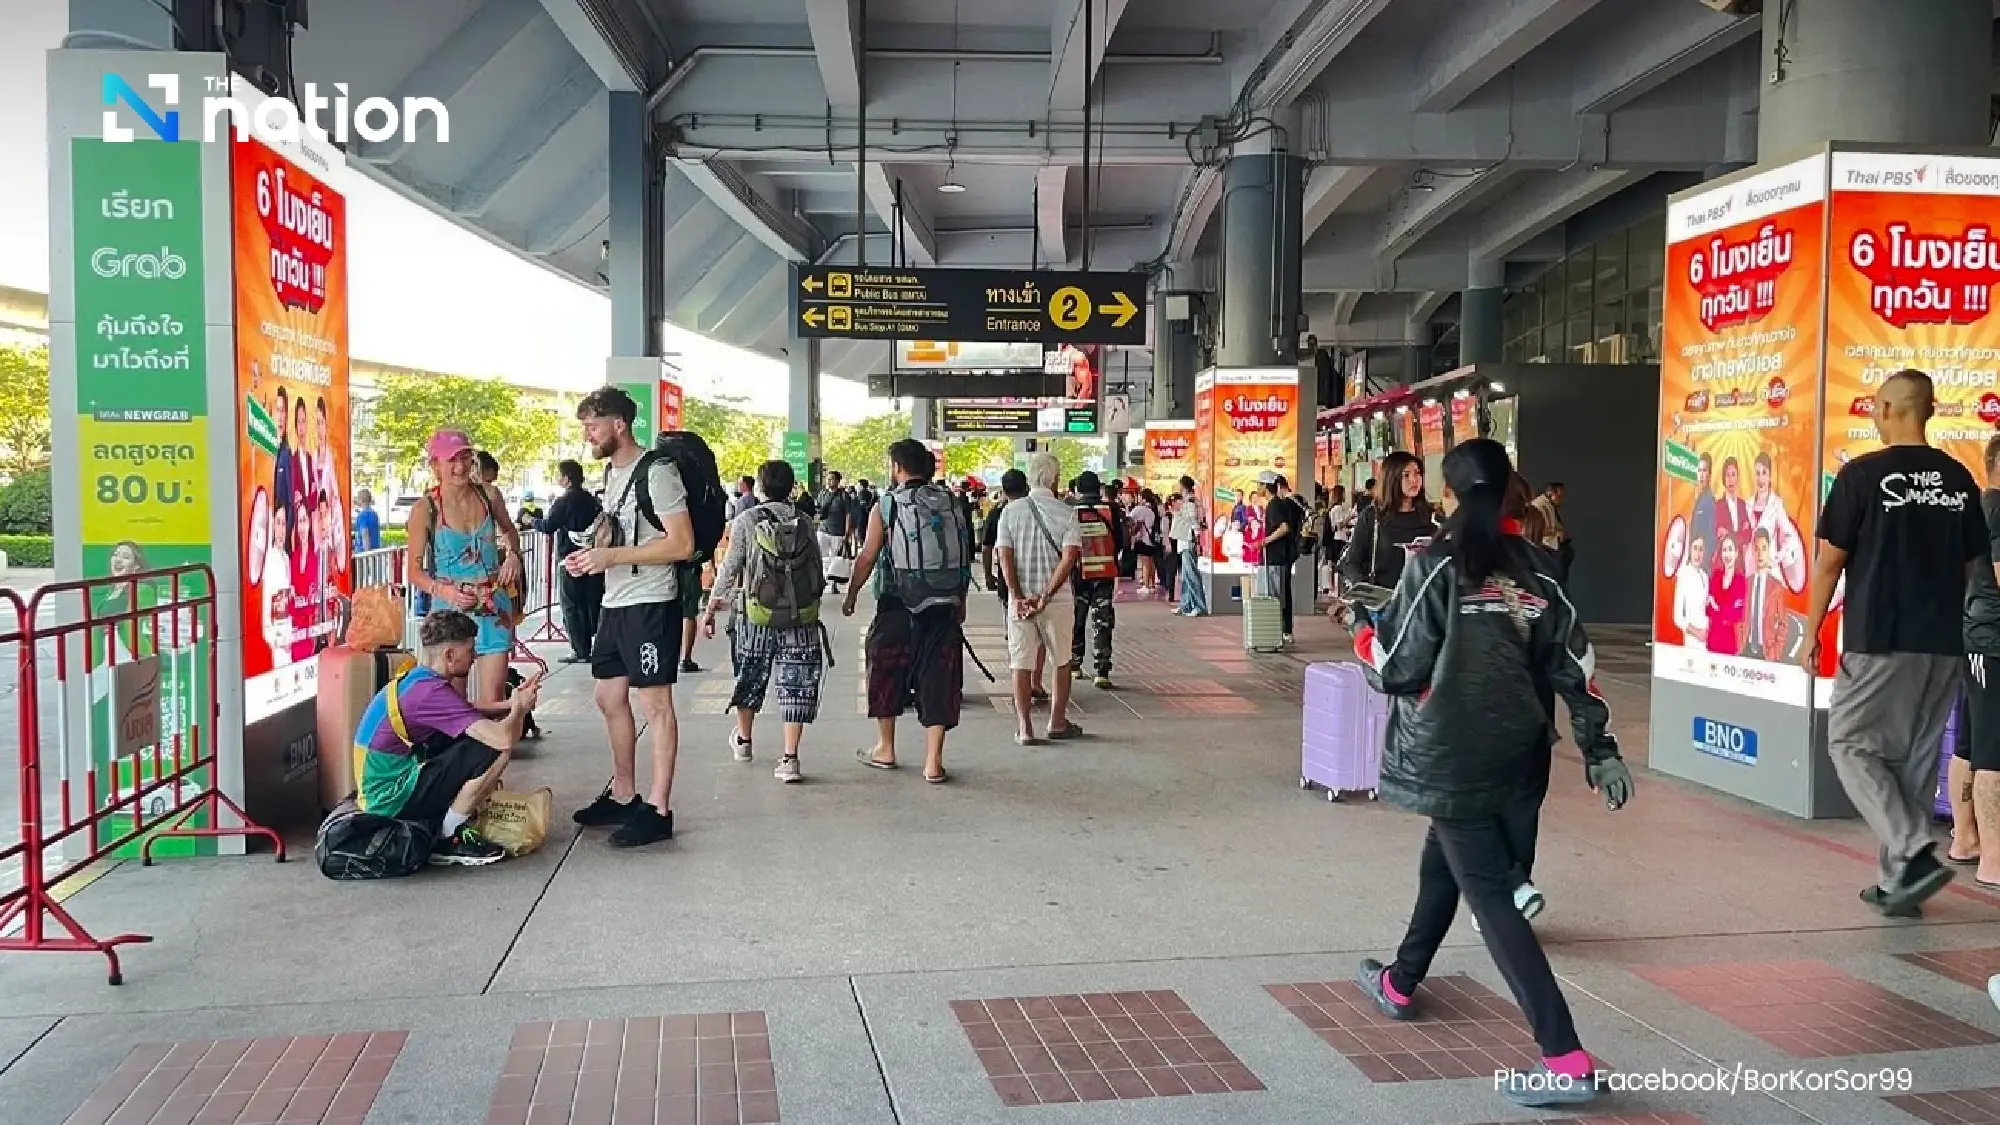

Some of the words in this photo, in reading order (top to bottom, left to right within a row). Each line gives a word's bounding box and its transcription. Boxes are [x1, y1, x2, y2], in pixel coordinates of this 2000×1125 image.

[1846, 169, 1880, 184] Thai
[1883, 171, 1913, 186] PBS
[101, 189, 174, 220] เรียก
[257, 170, 271, 218] 6
[275, 168, 333, 251] โมงเย็น
[1707, 205, 1726, 221] PBS
[92, 246, 187, 279] Grab
[1690, 253, 1704, 284] 6
[1711, 225, 1793, 280] โมงเย็น
[1853, 233, 1875, 267] 6
[271, 246, 309, 292] ทุกวัน
[854, 288, 881, 300] Public
[882, 288, 898, 300] Bus
[985, 281, 1041, 303] ทางเข้า
[1702, 284, 1750, 325] ทุกวัน
[1874, 278, 1951, 317] ทุกวัน
[1963, 284, 1987, 311] !!!
[1061, 294, 1079, 323] 2
[97, 314, 184, 341] คุ้มถึงใจ
[986, 316, 1041, 333] Entrance
[92, 345, 190, 370] มาไวถึงที่
[124, 409, 189, 421] NEWGRAB
[93, 443, 196, 467] ลดสูงสุด
[97, 475, 148, 504] 80
[1705, 721, 1745, 752] BNO
